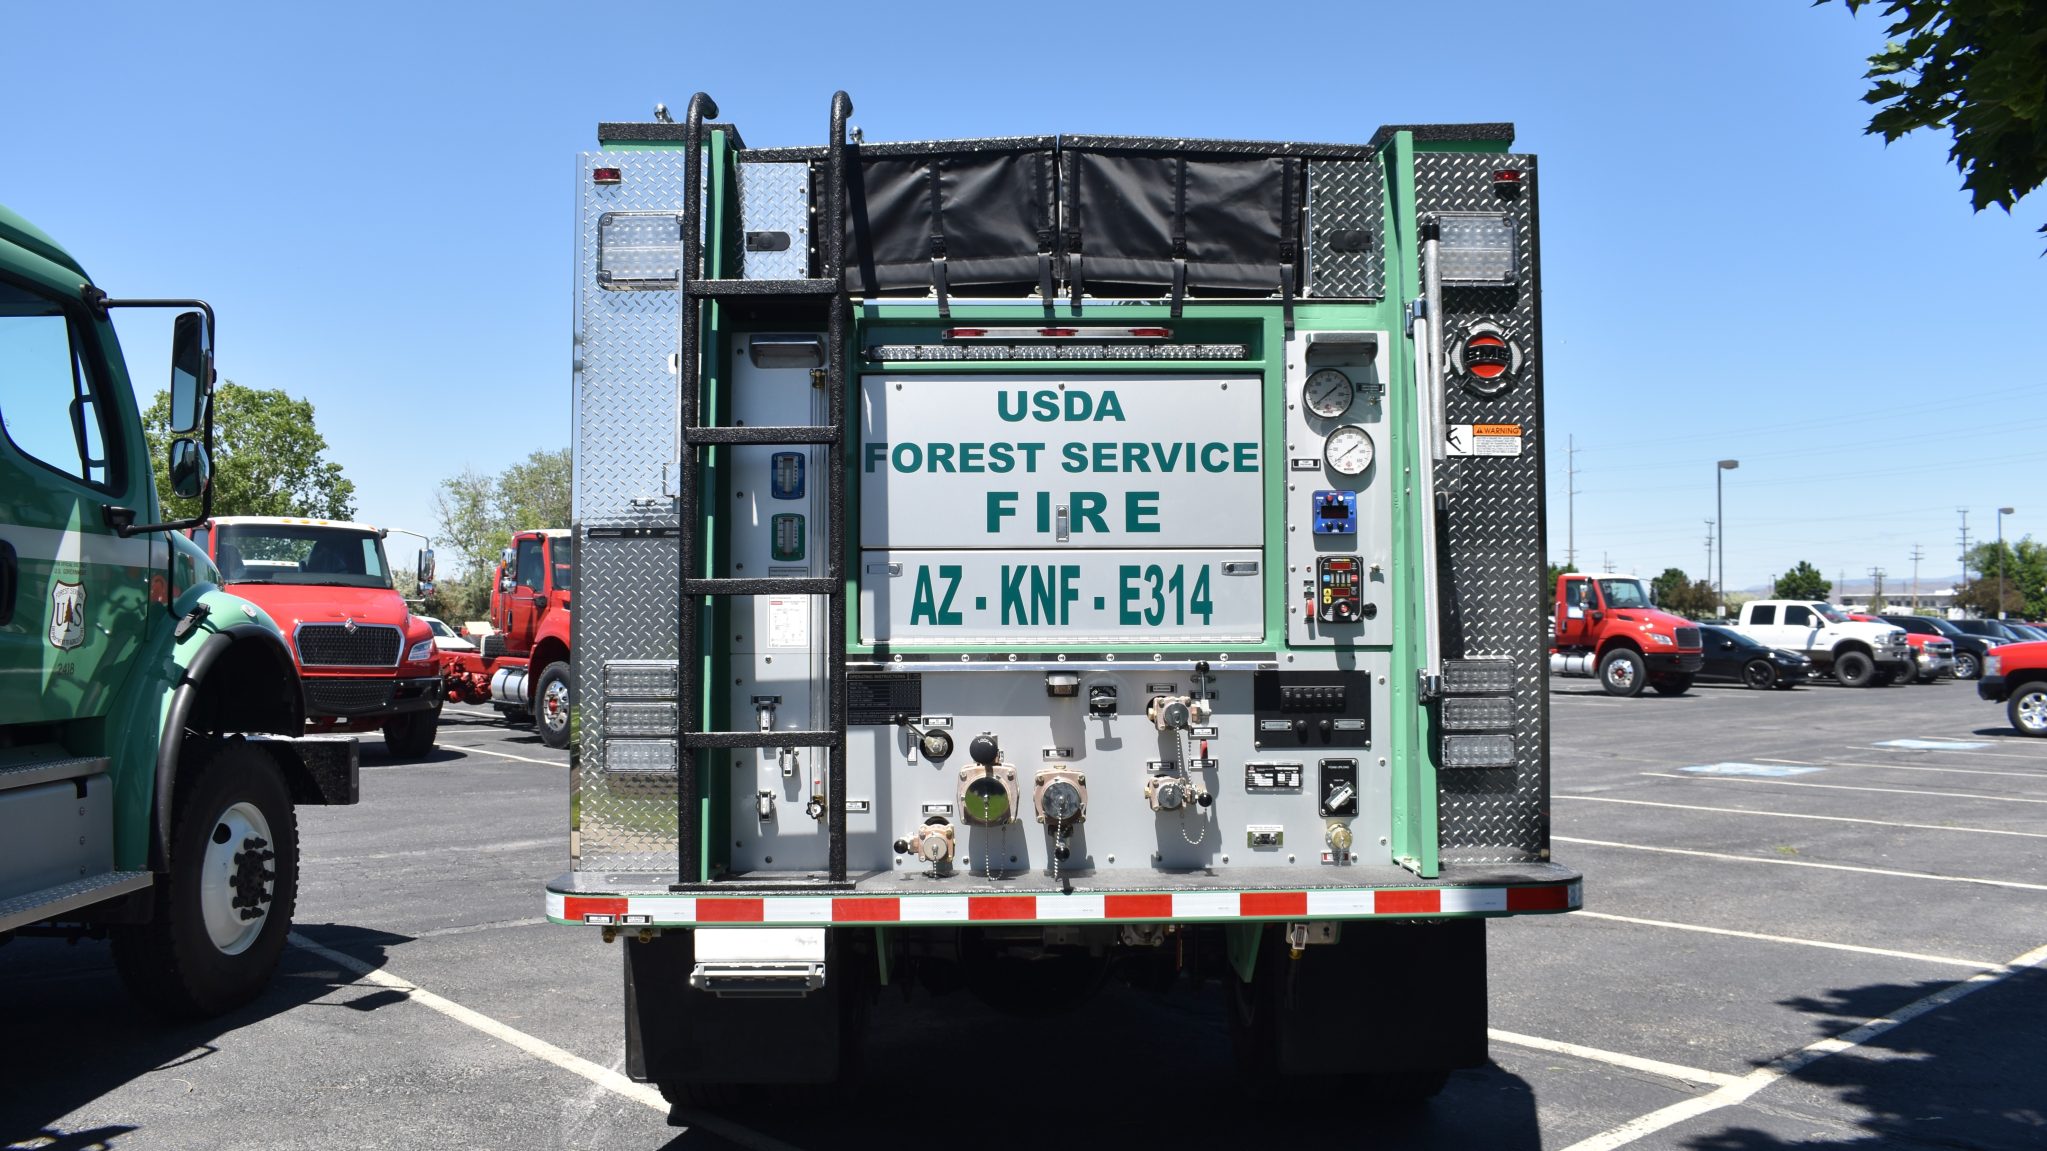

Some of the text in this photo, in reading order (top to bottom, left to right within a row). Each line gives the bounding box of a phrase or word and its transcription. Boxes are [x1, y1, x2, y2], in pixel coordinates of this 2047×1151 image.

[997, 390, 1126, 422] USDA
[865, 442, 1259, 473] FOREST SERVICE
[986, 491, 1161, 533] FIRE
[910, 565, 963, 626] AZ
[1001, 565, 1080, 626] KNF
[1119, 564, 1213, 626] E314
